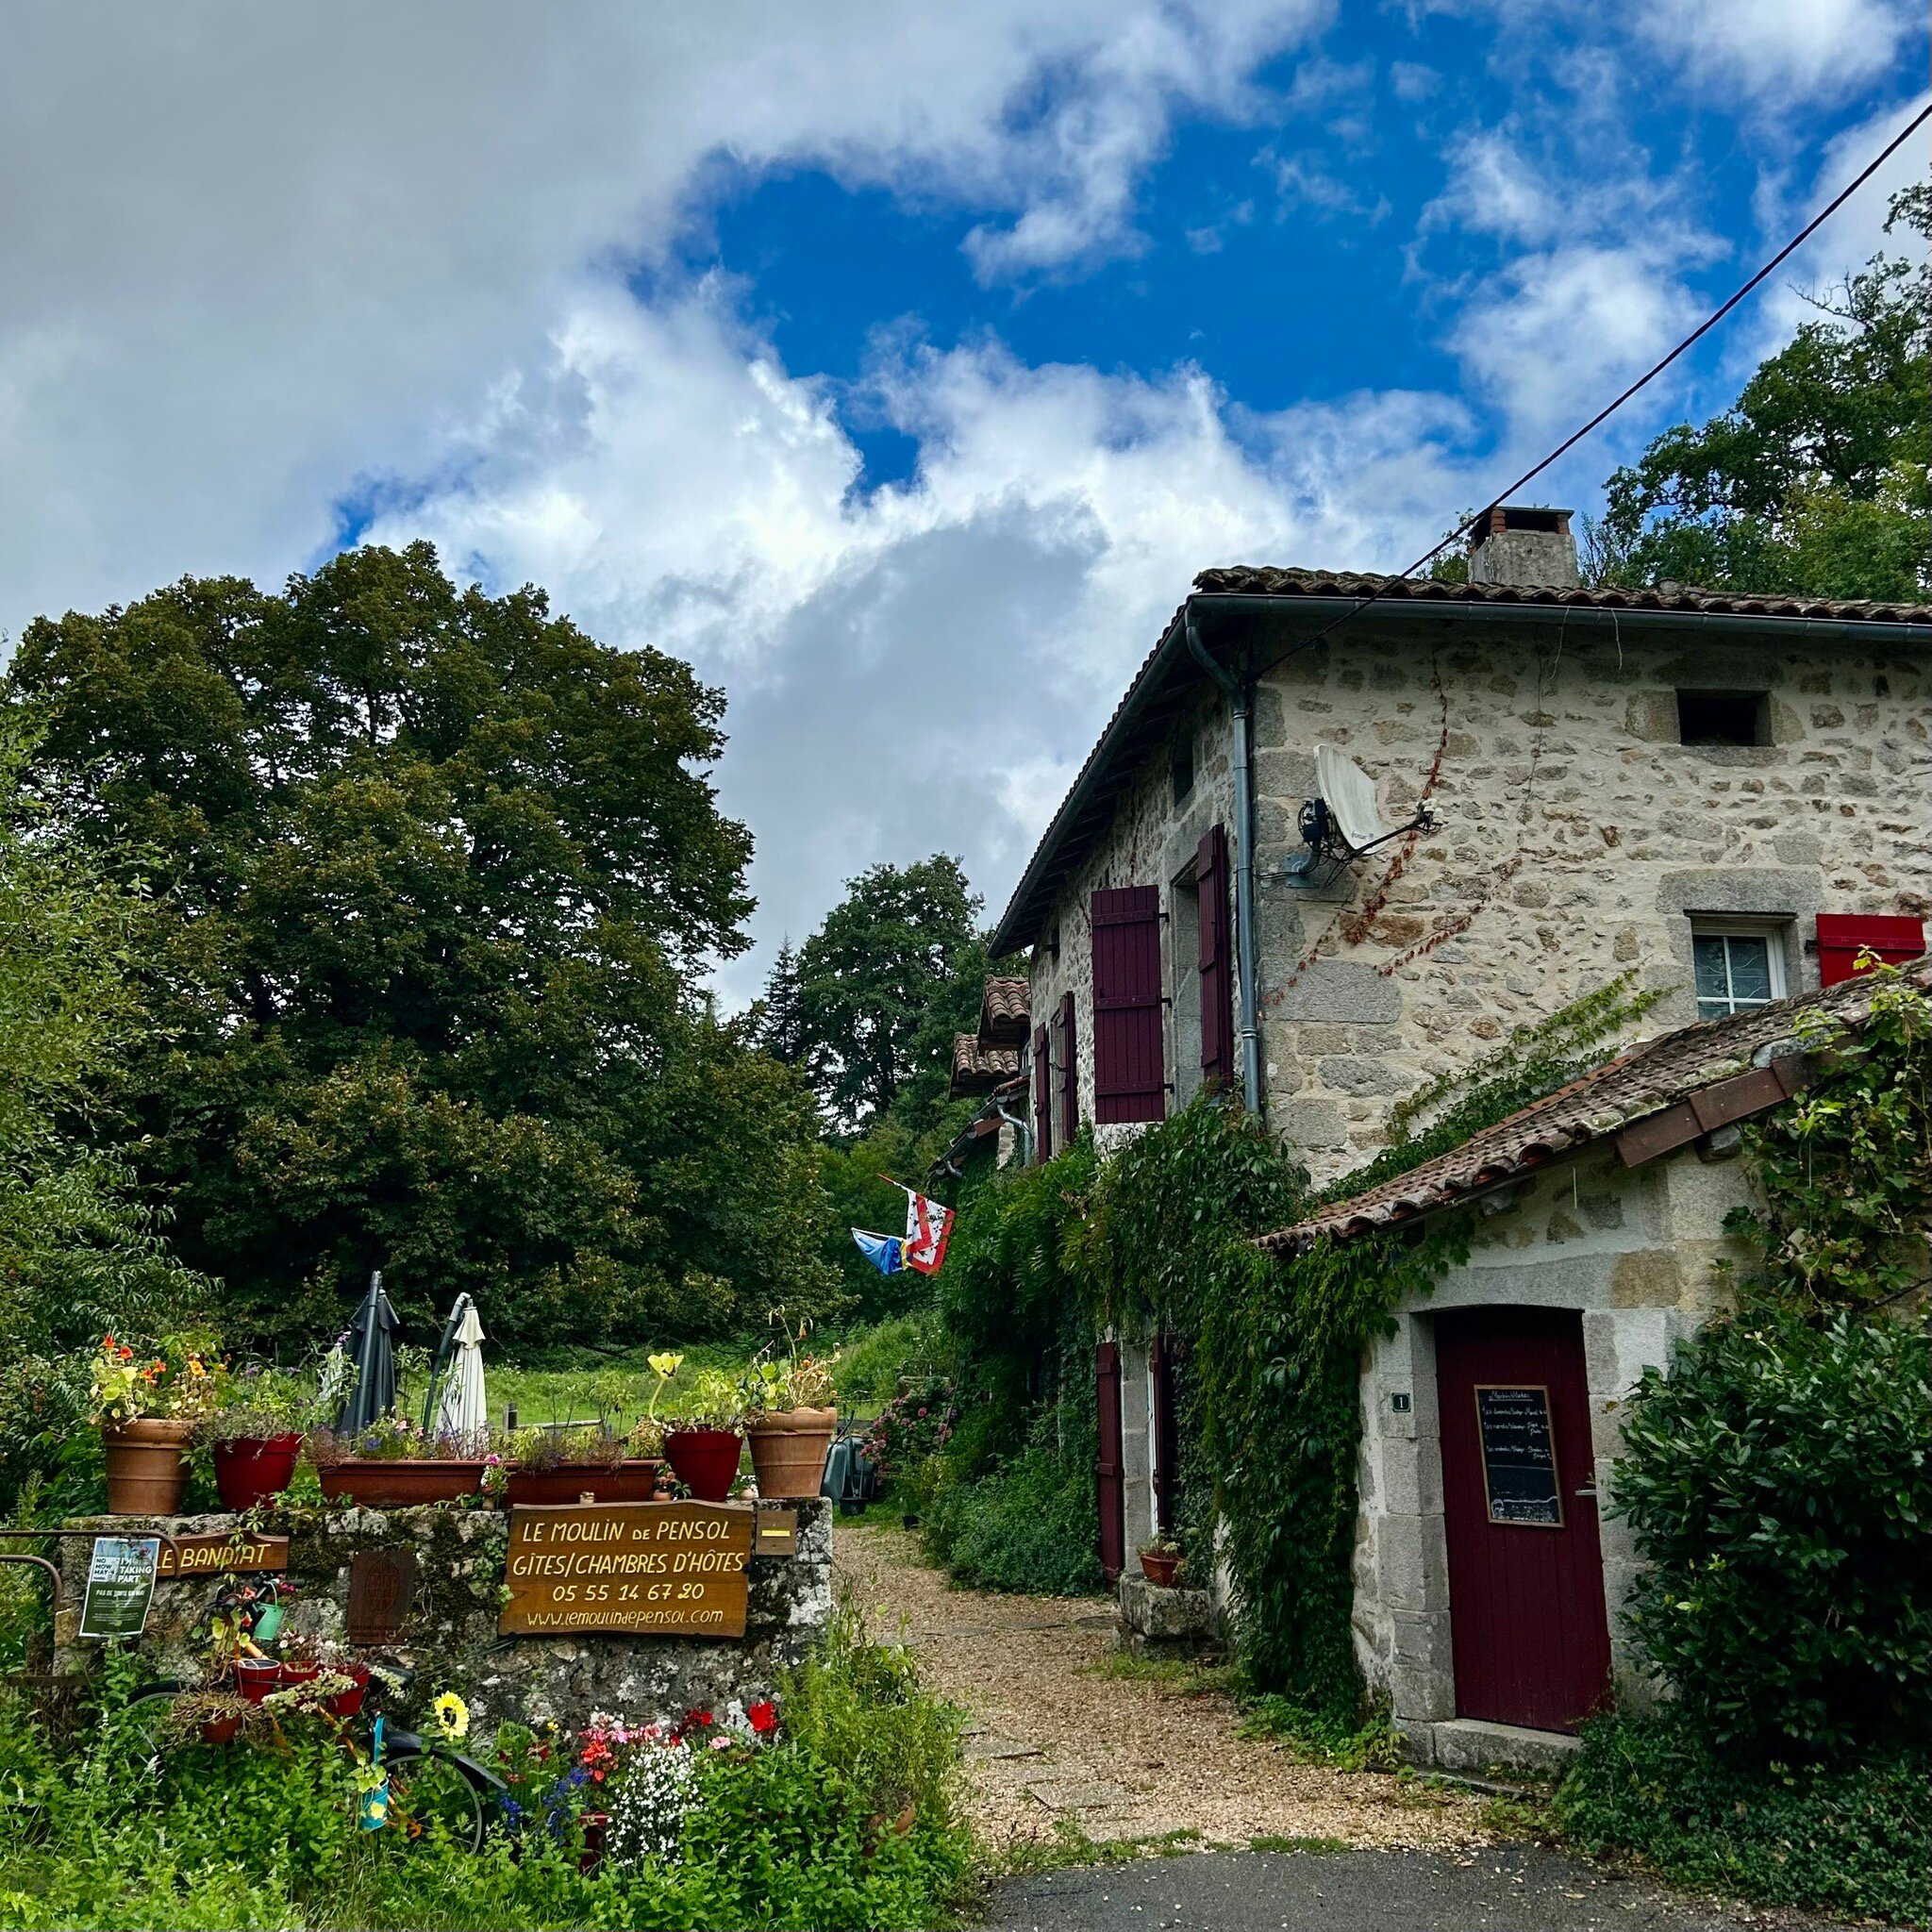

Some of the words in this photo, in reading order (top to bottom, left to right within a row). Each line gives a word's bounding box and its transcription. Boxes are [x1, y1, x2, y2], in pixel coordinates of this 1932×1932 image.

[1399, 1396, 1404, 1408] 1
[522, 1523, 545, 1542] LE
[632, 1528, 651, 1541] DE
[656, 1521, 730, 1541] PENSOL
[119, 1566, 153, 1574] TAKING
[512, 1552, 669, 1577] GÎTES/CHAMBRES
[673, 1549, 745, 1573] D'HÔTES
[553, 1585, 578, 1602] 05
[584, 1584, 609, 1601] 55
[618, 1584, 640, 1601] 14
[647, 1583, 673, 1600] 67
[677, 1582, 705, 1600] 20
[526, 1608, 724, 1629] www.lemoulindepensol.com
